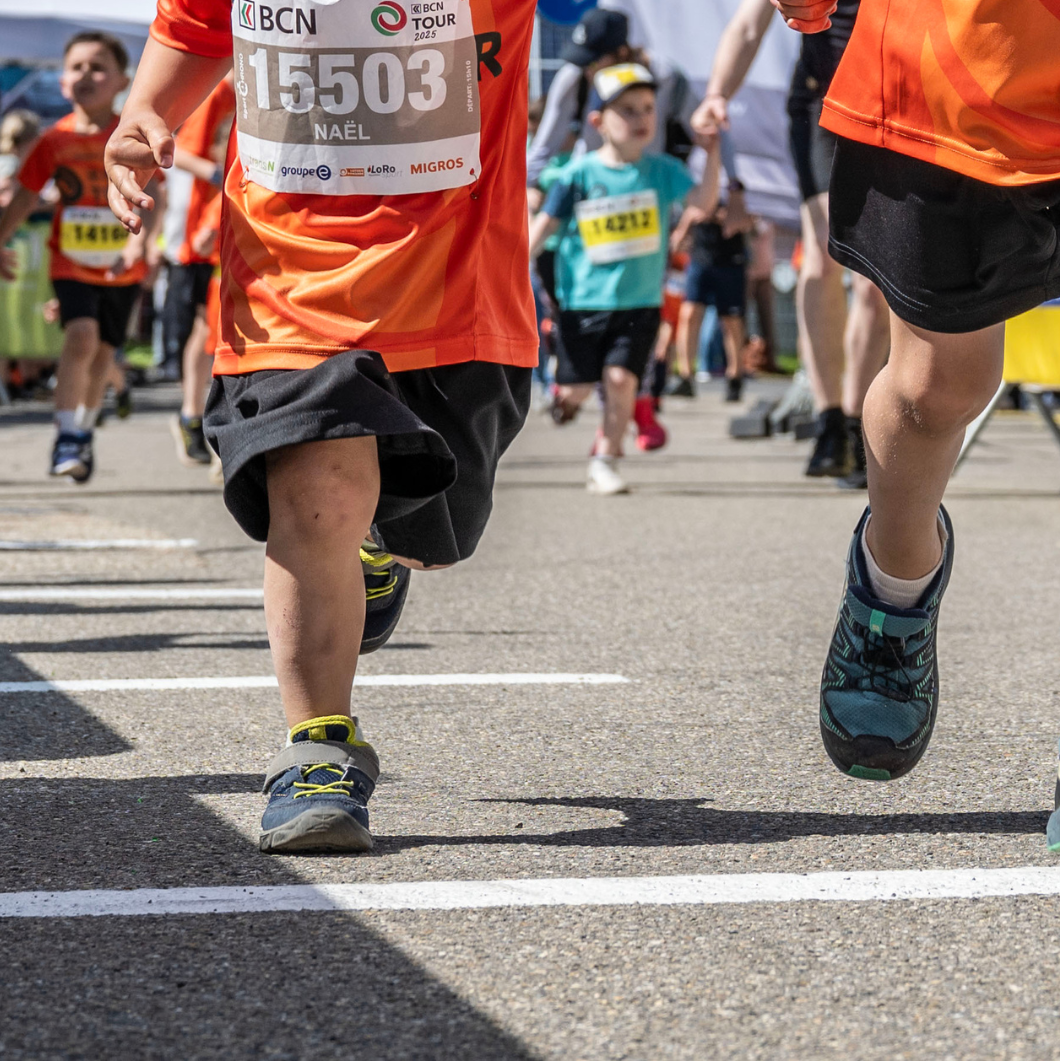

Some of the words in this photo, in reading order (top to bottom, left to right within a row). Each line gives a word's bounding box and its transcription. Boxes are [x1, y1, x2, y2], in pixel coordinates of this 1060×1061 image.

[422, 0, 444, 13] BCN
[259, 4, 317, 35] BCN
[411, 13, 457, 31] TOUR
[413, 29, 437, 41] 2025
[249, 48, 447, 114] 15503
[313, 120, 371, 141] NAËL
[281, 166, 316, 178] groupe
[410, 157, 464, 175] MIGROS
